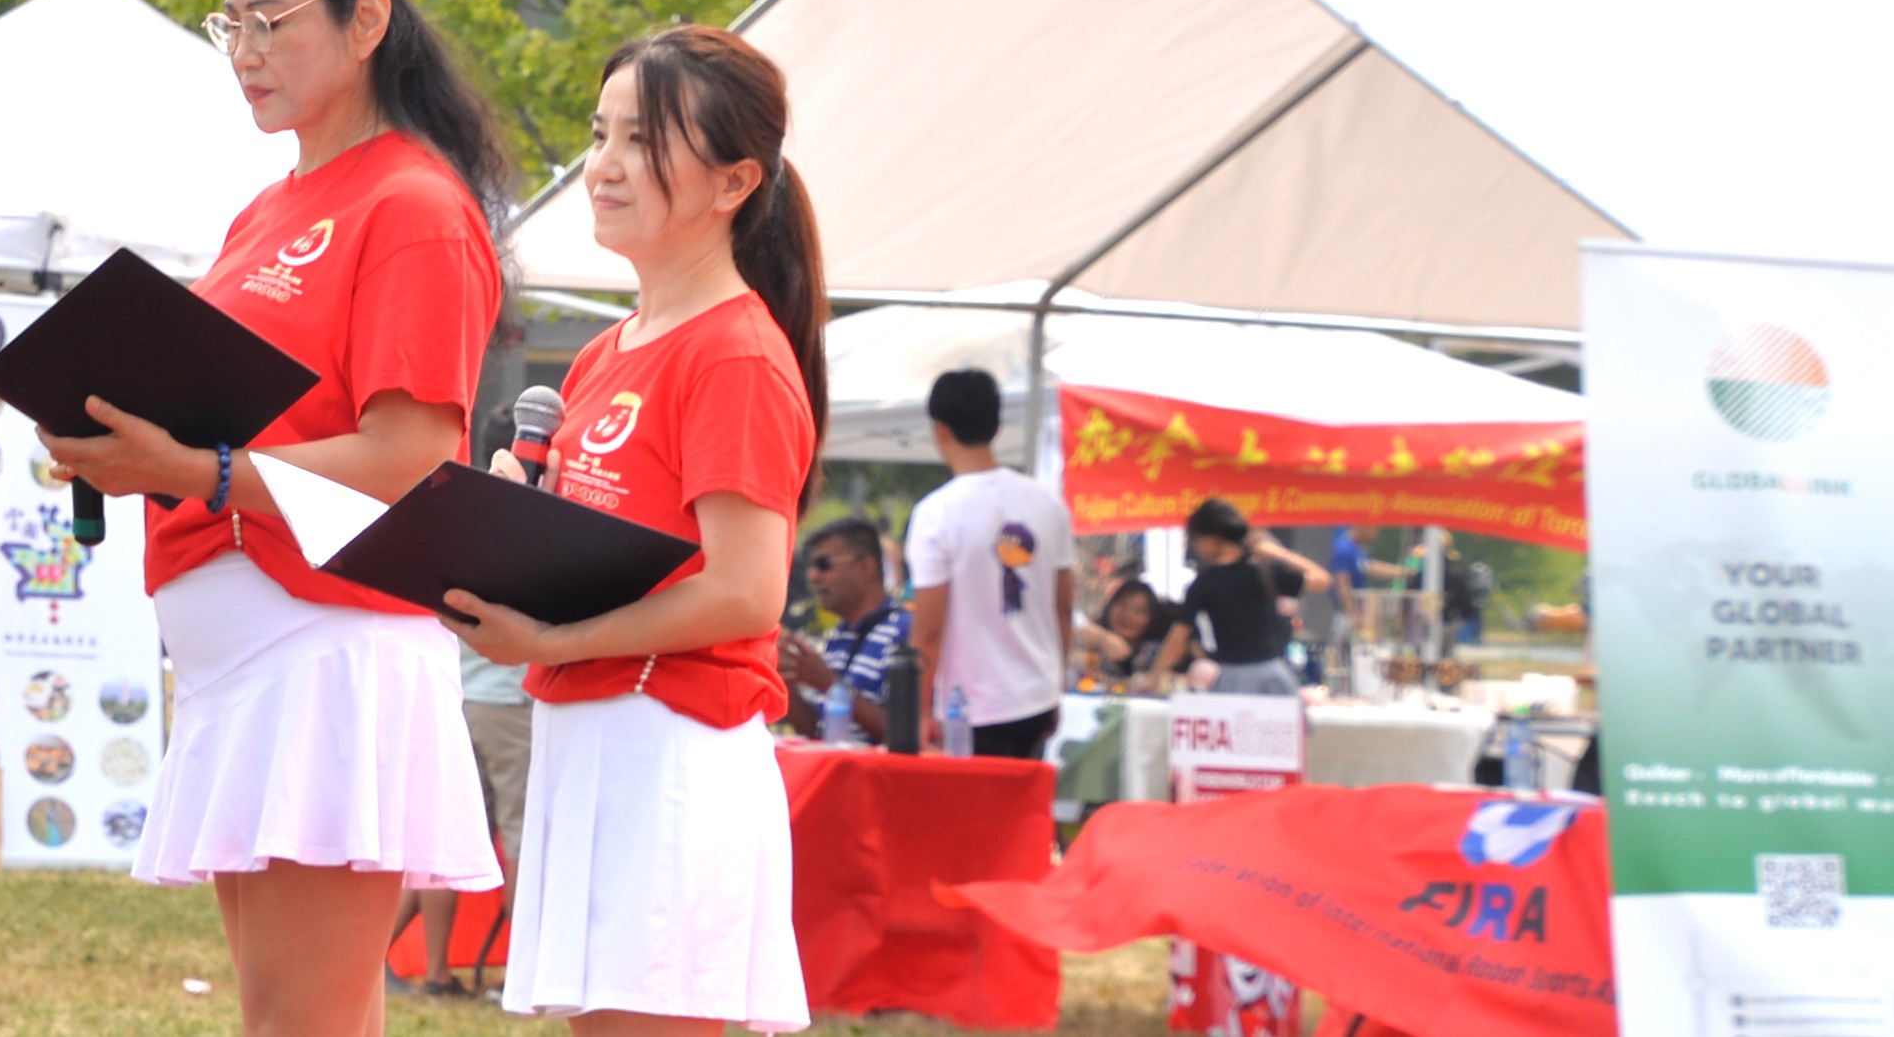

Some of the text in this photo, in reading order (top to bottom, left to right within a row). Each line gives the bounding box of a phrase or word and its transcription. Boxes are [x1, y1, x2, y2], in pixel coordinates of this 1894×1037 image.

[1120, 491, 1177, 517] Culture
[1266, 486, 1280, 510] &
[1283, 486, 1385, 519] Community
[1720, 562, 1822, 589] YOUR
[1711, 599, 1853, 629] GLOBAL
[1706, 636, 1865, 666] PARTNER
[1170, 716, 1233, 750] FIRA
[1294, 891, 1325, 909] of
[1399, 882, 1548, 943] FIRA
